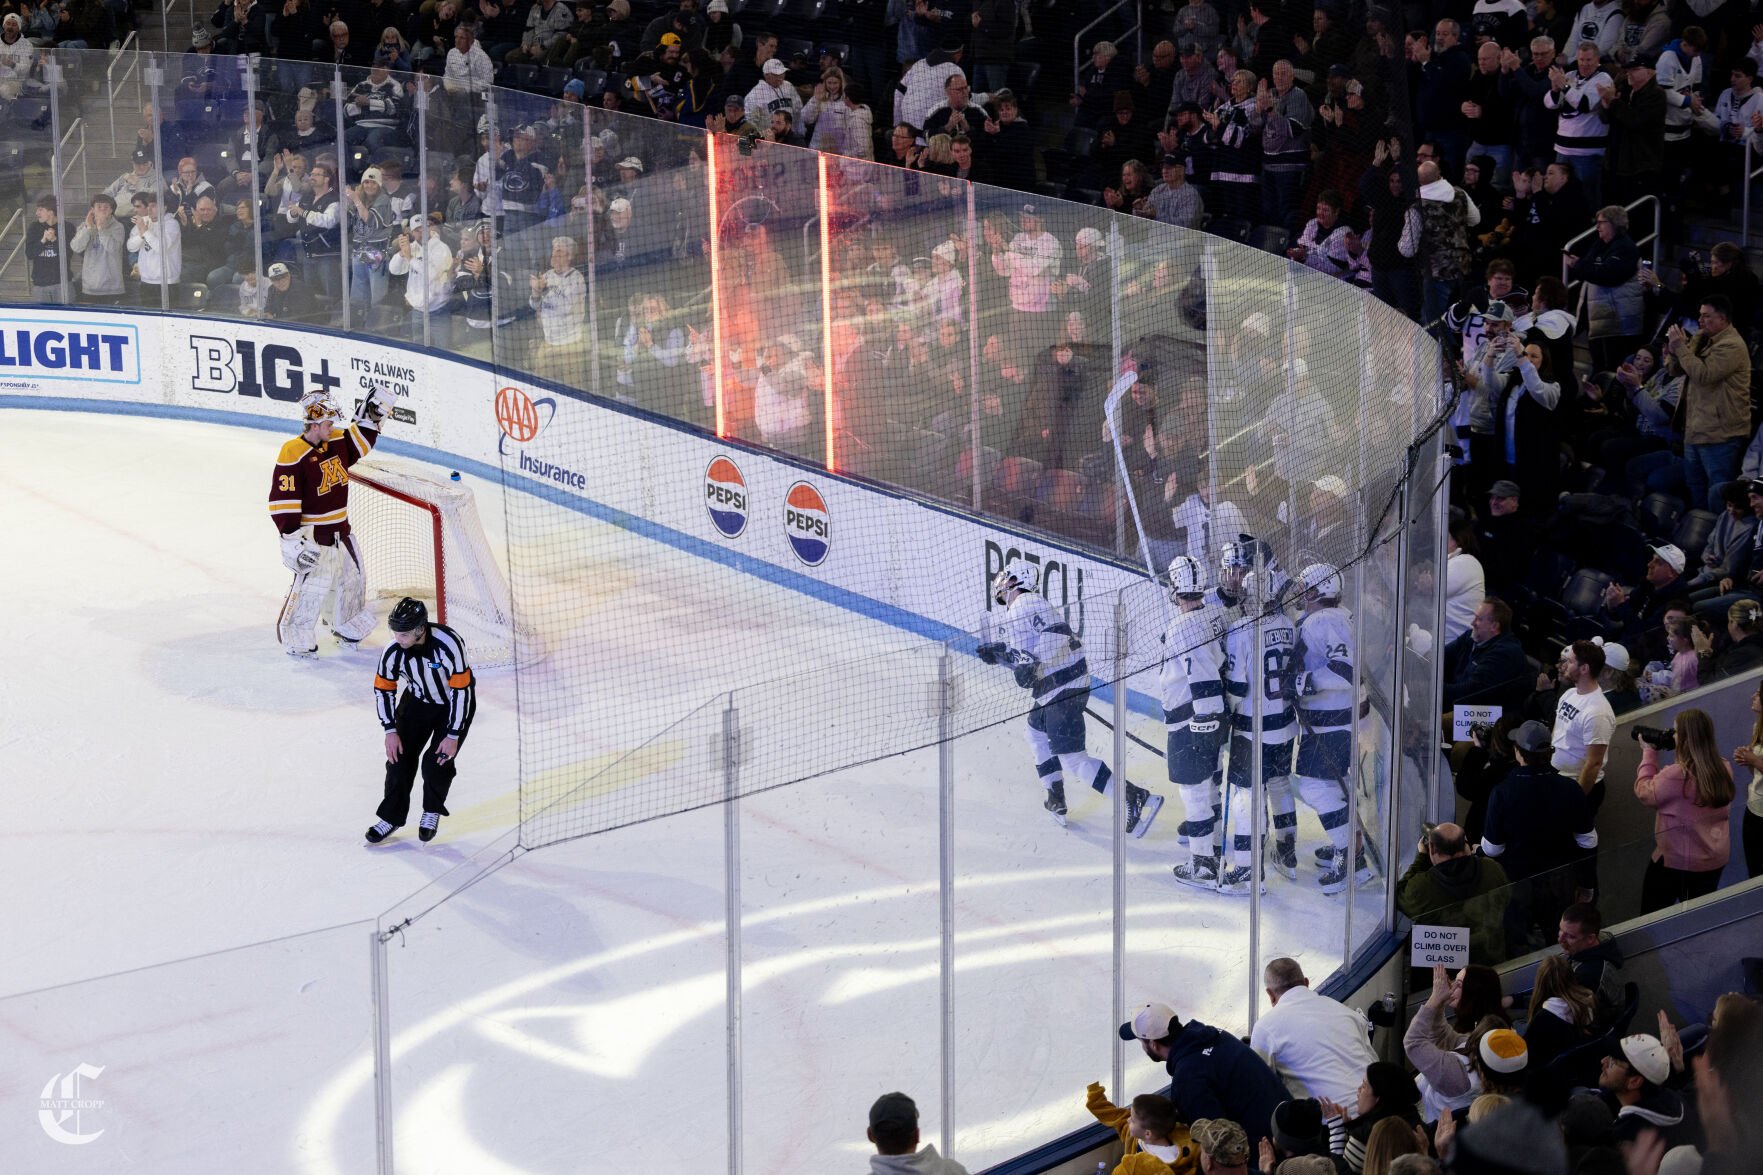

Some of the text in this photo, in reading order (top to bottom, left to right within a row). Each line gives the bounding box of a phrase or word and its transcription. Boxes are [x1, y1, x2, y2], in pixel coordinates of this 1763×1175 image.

[351, 357, 416, 382] IT'S ALWAYS
[394, 383, 409, 398] ON
[499, 388, 537, 440] AAA
[317, 455, 349, 496] M
[519, 450, 586, 490] Insurance
[278, 475, 296, 491] 31
[707, 483, 746, 510] PEPSI
[786, 509, 828, 538] PEPSI
[985, 539, 1084, 638] PCU
[1326, 643, 1348, 659] 24
[1559, 701, 1581, 720] PSU
[1424, 931, 1458, 940] DO NOT
[1414, 942, 1467, 952] CLIMB OVER
[1425, 954, 1455, 963] GLASS
